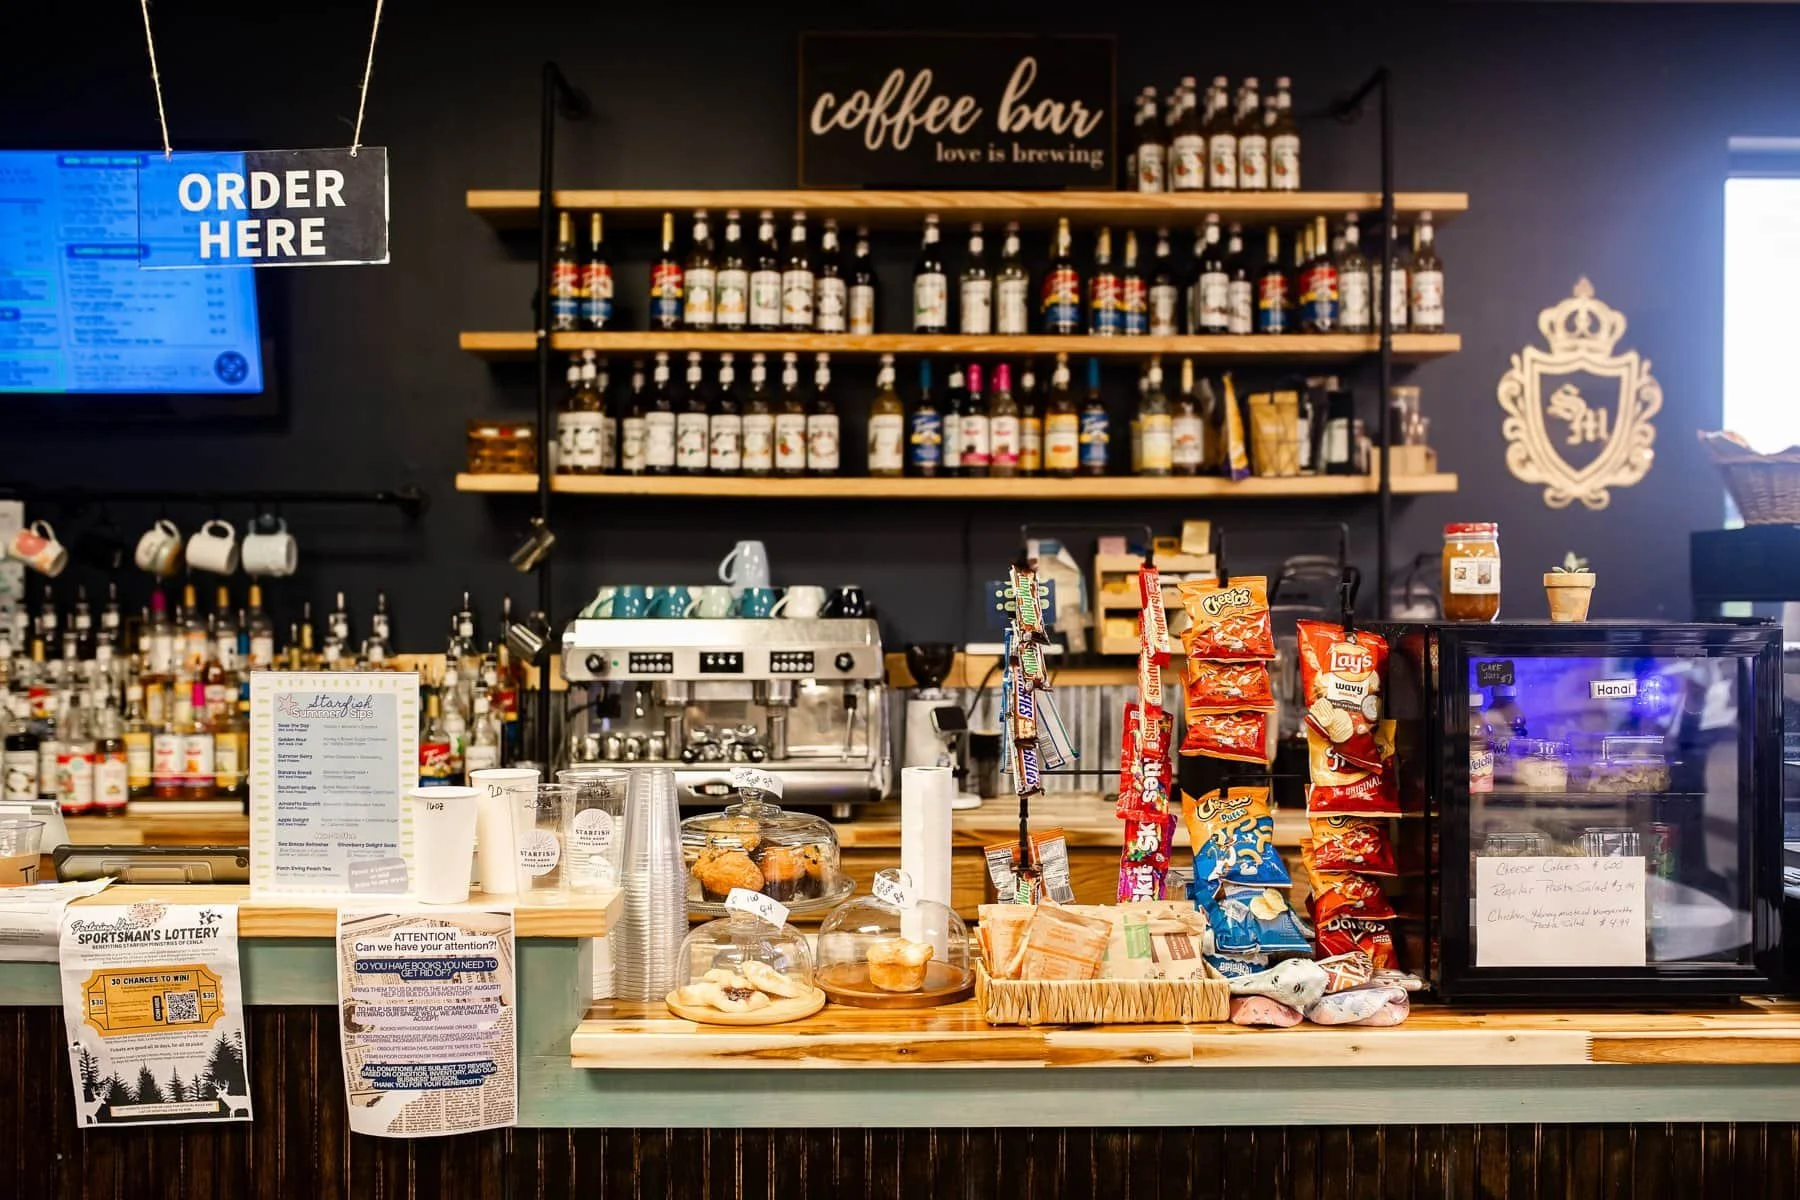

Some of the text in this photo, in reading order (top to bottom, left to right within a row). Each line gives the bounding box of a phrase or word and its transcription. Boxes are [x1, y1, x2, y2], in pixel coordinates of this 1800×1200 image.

[810, 56, 1105, 151] coffee bar
[935, 141, 1105, 170] love is brewing
[177, 168, 347, 212] ORDER
[199, 217, 327, 259] HERE
[1202, 589, 1250, 616] Cheetos
[1330, 652, 1373, 674] Lay's
[1335, 682, 1364, 695] wavy
[308, 693, 373, 718] Starfish
[291, 708, 374, 722] Summer Sips
[1344, 775, 1383, 796] ORIGINAL
[77, 926, 220, 945] SPORTSMAN'S LOTTERY
[393, 932, 457, 942] ATTENTION!
[355, 940, 497, 953] Can we have your attention?!
[355, 960, 498, 971] DO YOU HAVE BOOKS YOU NEED TO
[401, 969, 452, 978] GET RID OF?
[111, 978, 121, 986] 30
[123, 976, 159, 985] CHANCES
[173, 974, 190, 982] WIN!
[443, 1004, 483, 1012] COMMUNITY
[428, 1064, 458, 1072] SUBJECT
